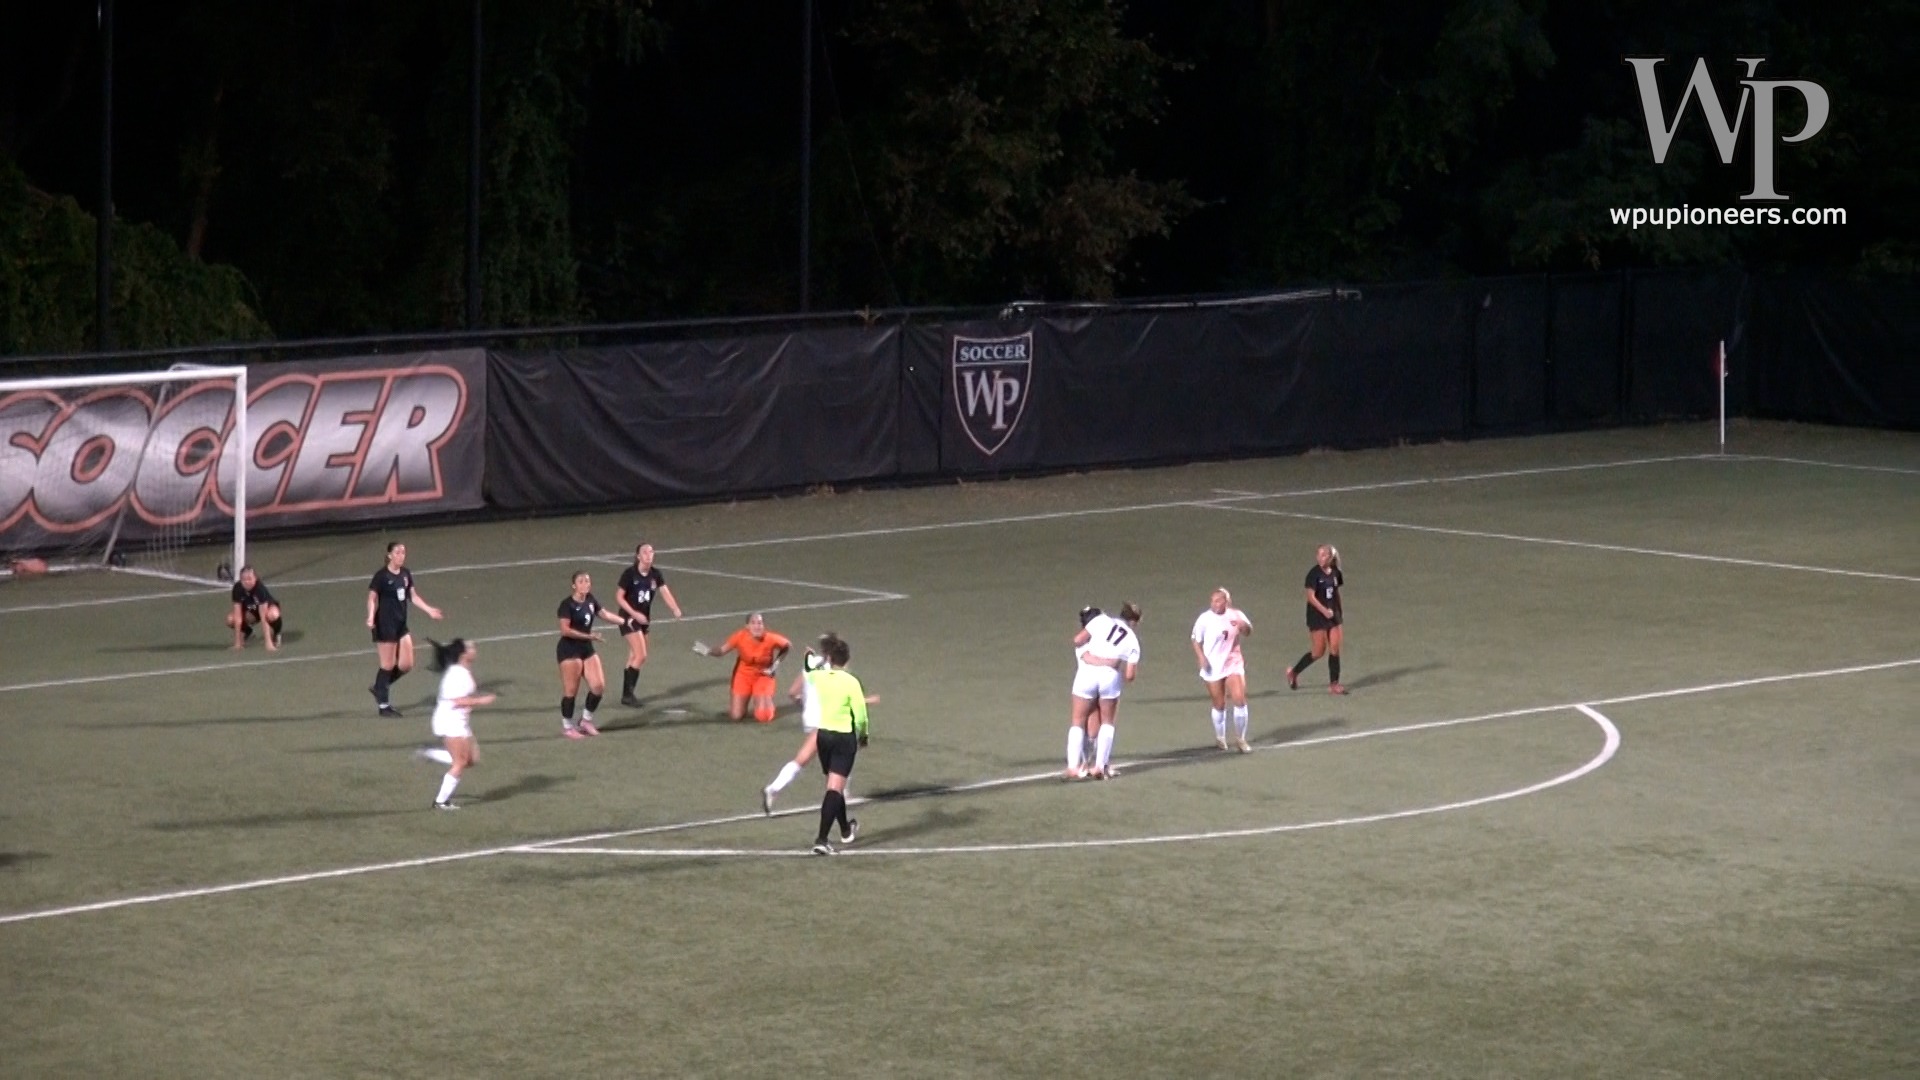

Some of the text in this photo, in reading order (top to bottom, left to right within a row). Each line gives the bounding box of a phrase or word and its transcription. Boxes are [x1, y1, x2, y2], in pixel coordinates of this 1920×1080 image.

[960, 344, 1026, 361] SOCCER
[962, 370, 1020, 430] WP
[1106, 624, 1128, 646] 17
